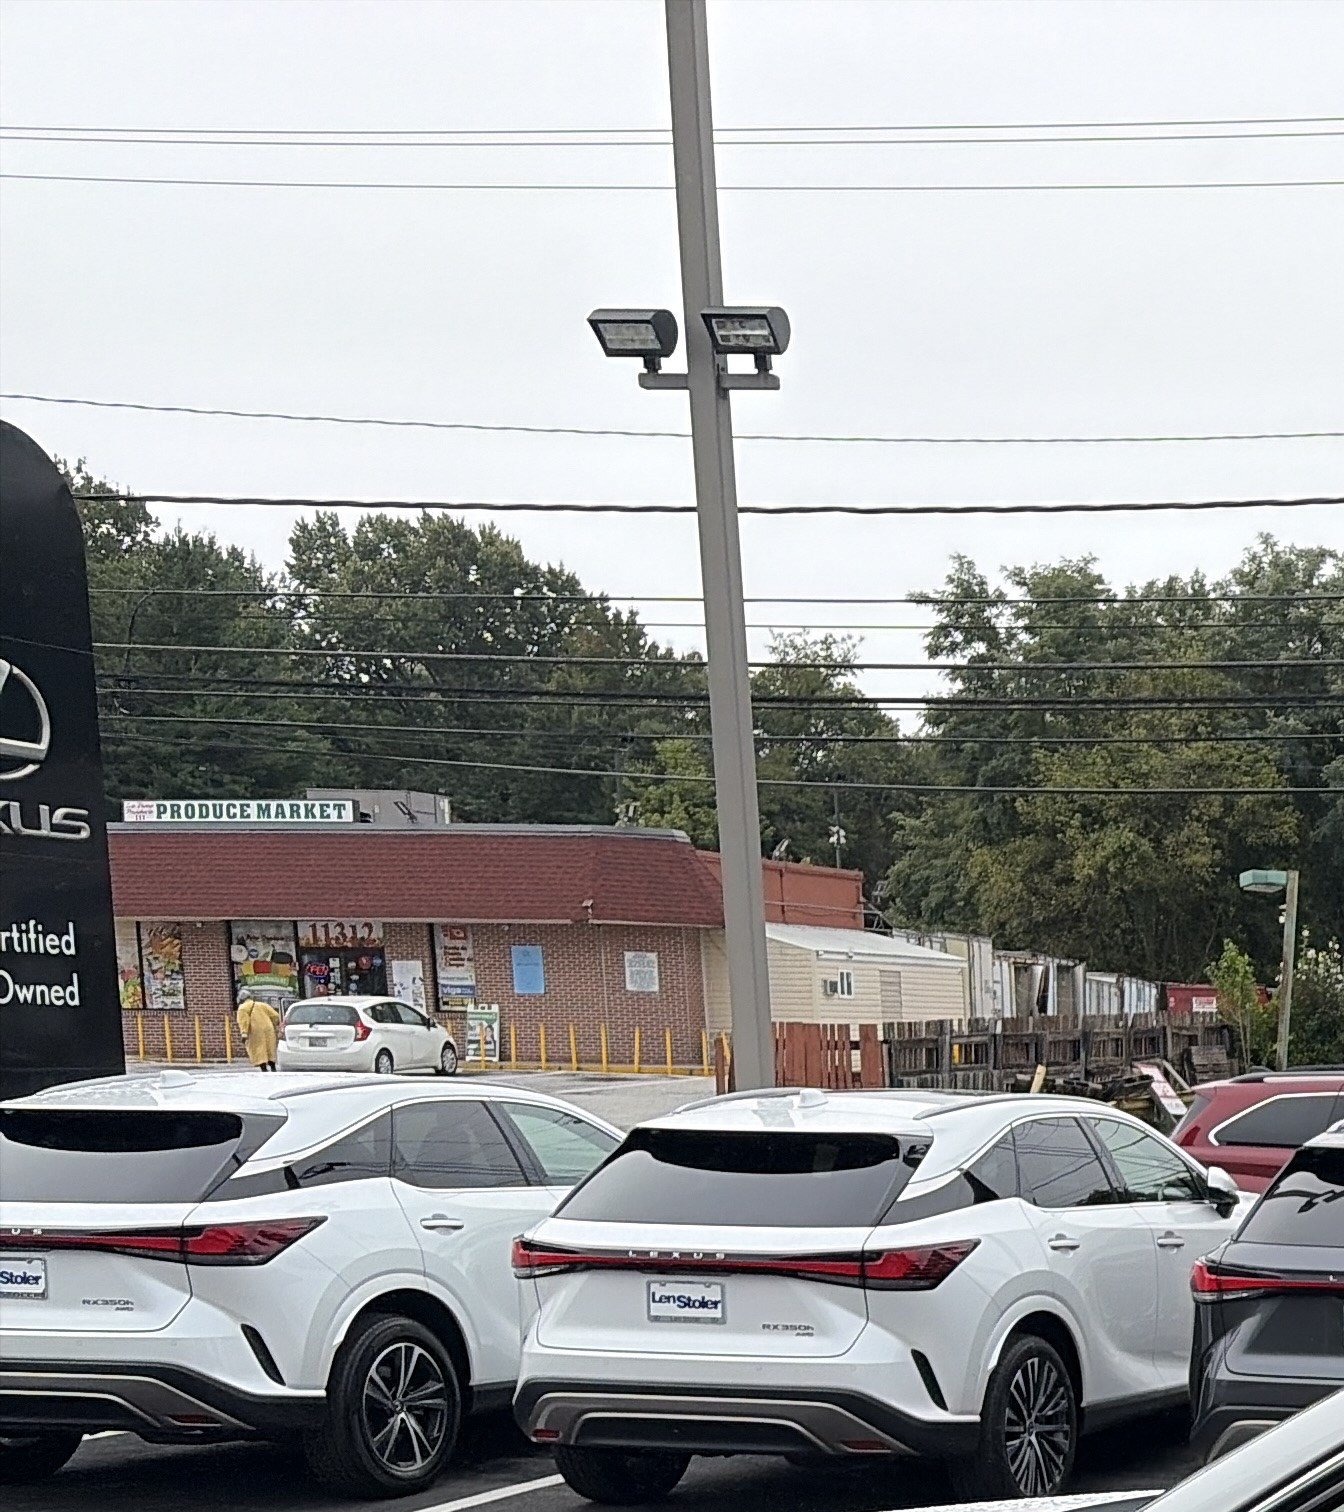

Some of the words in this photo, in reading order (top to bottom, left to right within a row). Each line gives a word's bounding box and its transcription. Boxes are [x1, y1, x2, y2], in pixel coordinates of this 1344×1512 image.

[156, 803, 251, 820] PRODUCE
[256, 803, 347, 820] MARKET
[0, 919, 77, 956] rtified
[308, 921, 377, 947] 11312
[628, 1250, 725, 1260] LEXUS
[0, 1270, 42, 1285] Stoler
